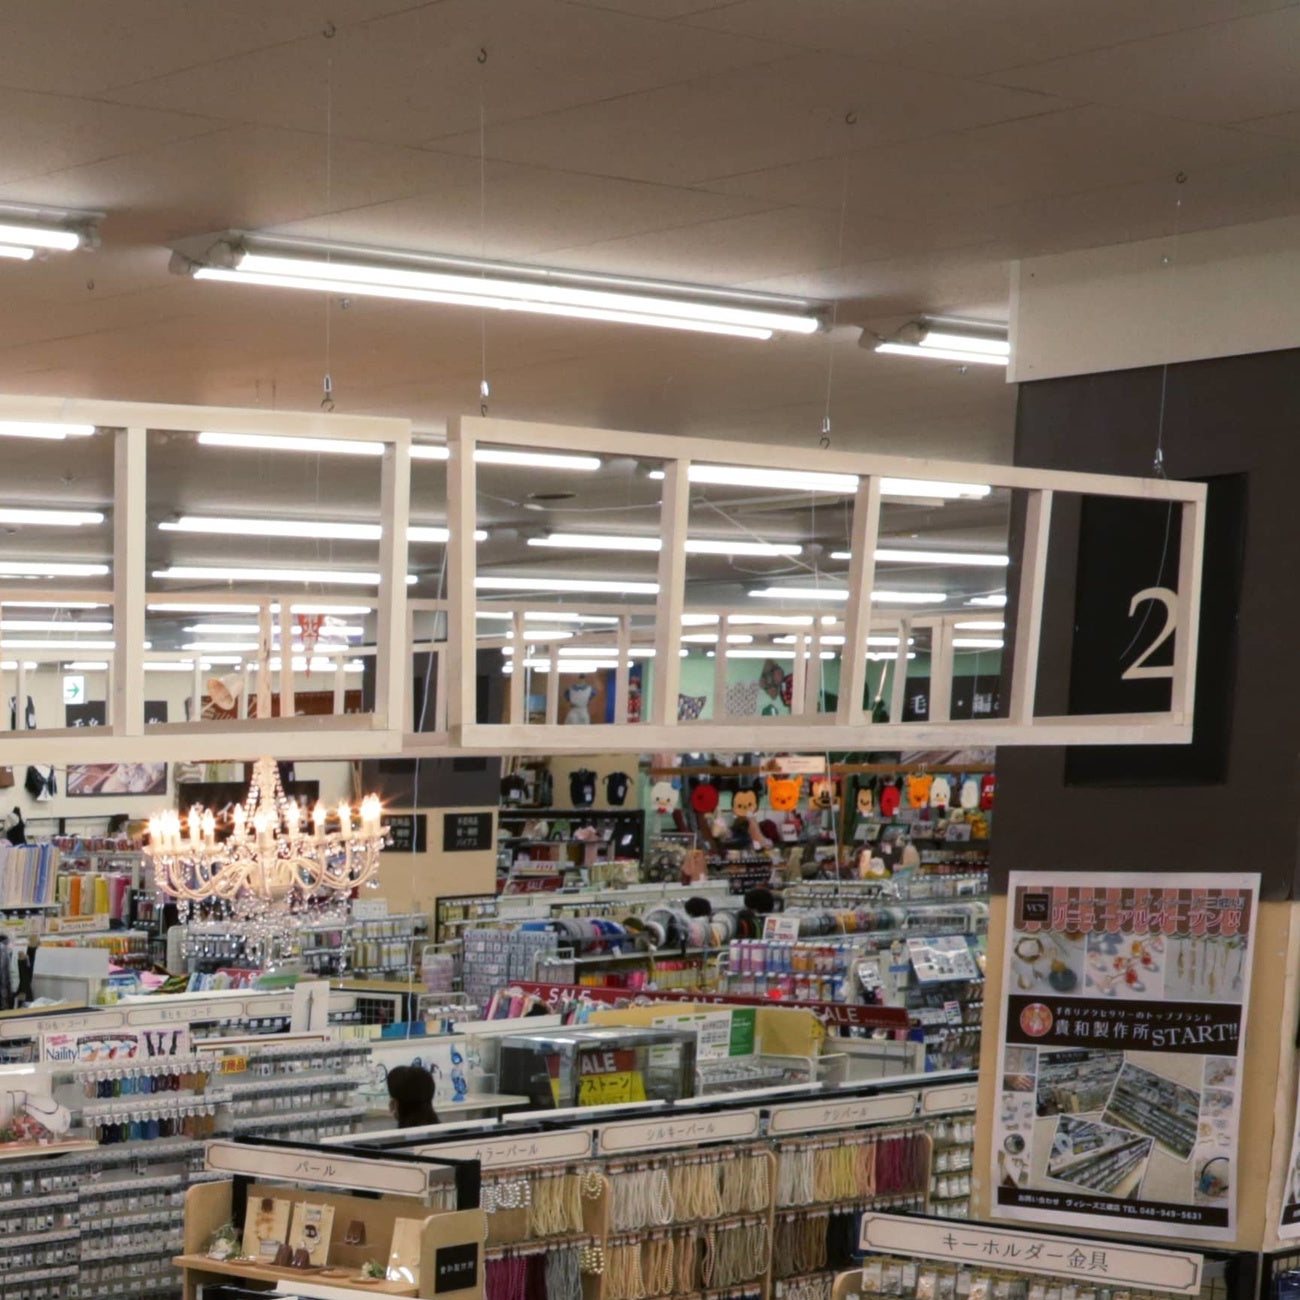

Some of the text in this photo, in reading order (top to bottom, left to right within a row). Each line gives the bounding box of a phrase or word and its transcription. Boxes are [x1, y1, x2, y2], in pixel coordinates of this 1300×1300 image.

[1121, 586, 1179, 680] 2
[1054, 1018, 1150, 1041] 貴和製作所
[581, 1053, 617, 1075] ALE
[645, 1122, 717, 1142] シルキーパール
[294, 1161, 337, 1177] パール
[1122, 1205, 1138, 1215] TEL
[942, 1232, 1110, 1273] キーホルダー金具
